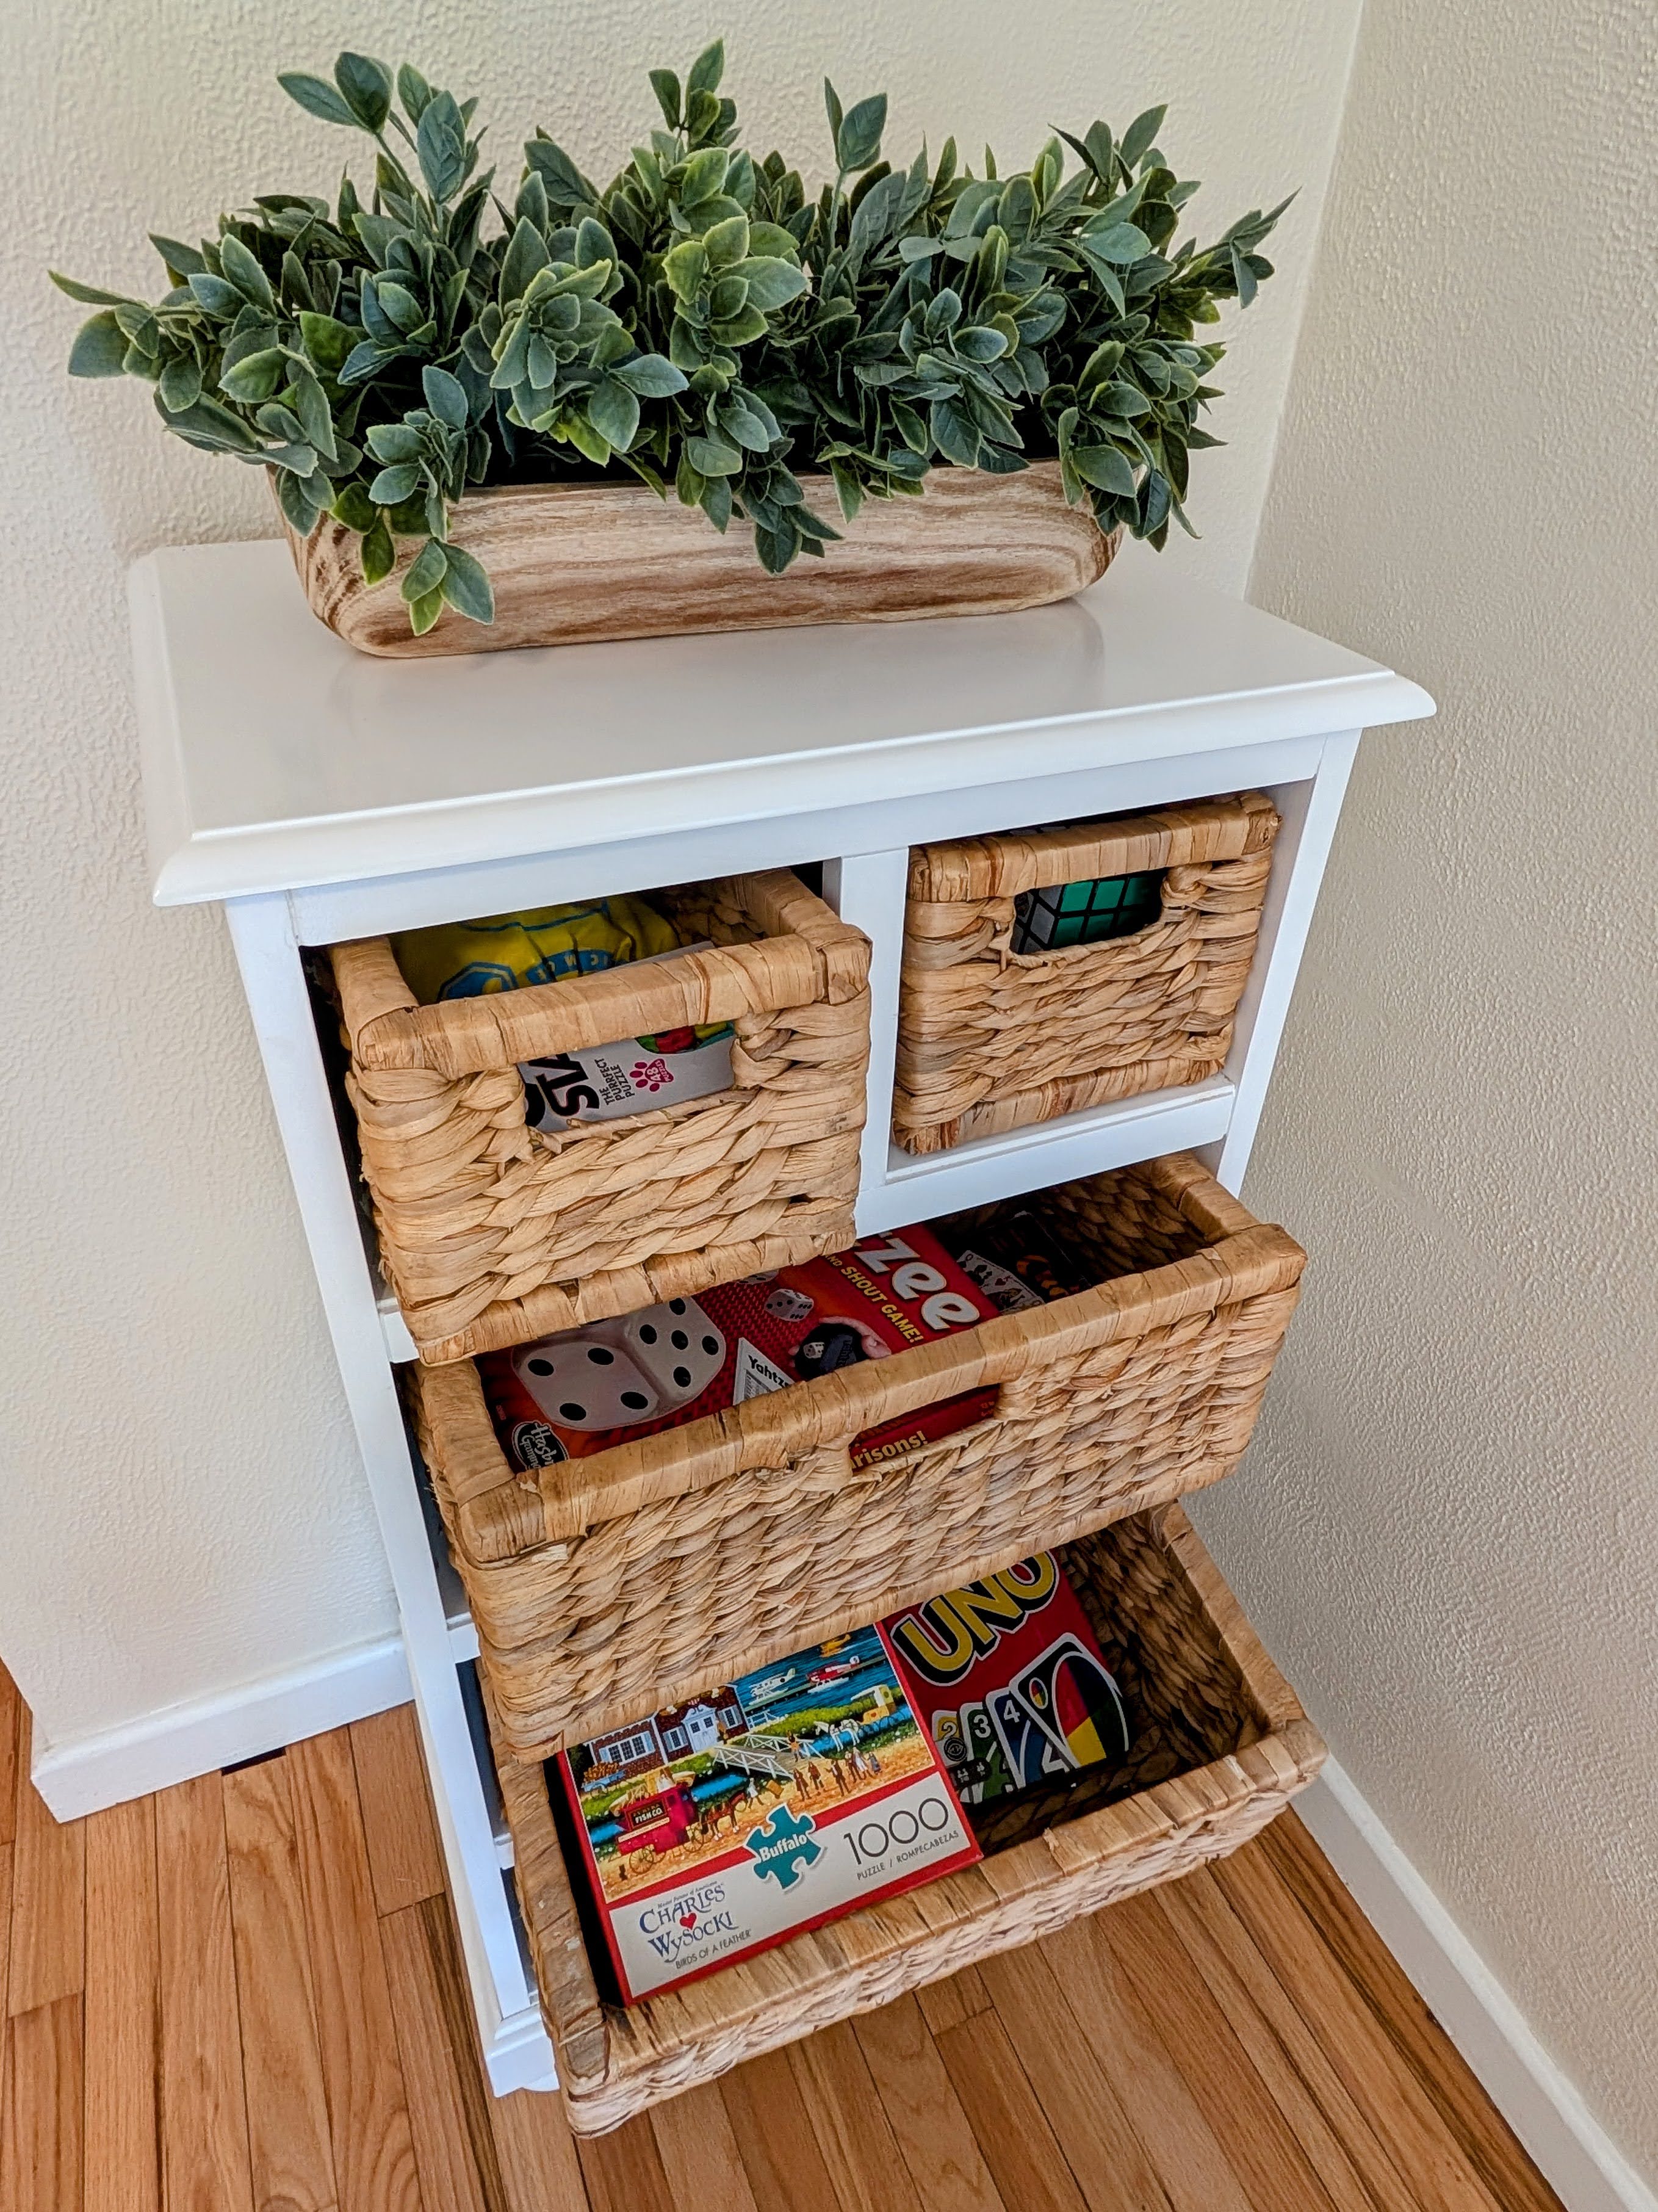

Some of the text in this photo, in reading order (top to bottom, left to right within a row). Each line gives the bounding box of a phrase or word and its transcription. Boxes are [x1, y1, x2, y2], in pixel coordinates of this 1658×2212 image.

[594, 1058, 625, 1101] PURRFECT
[610, 1064, 635, 1098] PUZZLE
[647, 1067, 661, 1081] 48
[599, 1086, 615, 1105] THE
[854, 1232, 980, 1330] zee
[841, 1267, 888, 1302] SHOUT
[882, 1304, 924, 1343] GAME!
[748, 1354, 790, 1389] Yahtz
[530, 1422, 557, 1466] Hasbr
[891, 1550, 1059, 1686] UNO
[942, 1700, 1020, 1740] 2 3 4
[759, 1833, 807, 1862] Buffalo
[844, 1798, 949, 1865] 1000
[857, 1863, 885, 1881] PUZZLE
[896, 1830, 959, 1863] ROMPECABEZAS
[676, 1953, 697, 1968] BIRDS
[712, 1945, 719, 1954] A
[719, 1929, 751, 1949] FEATHER
